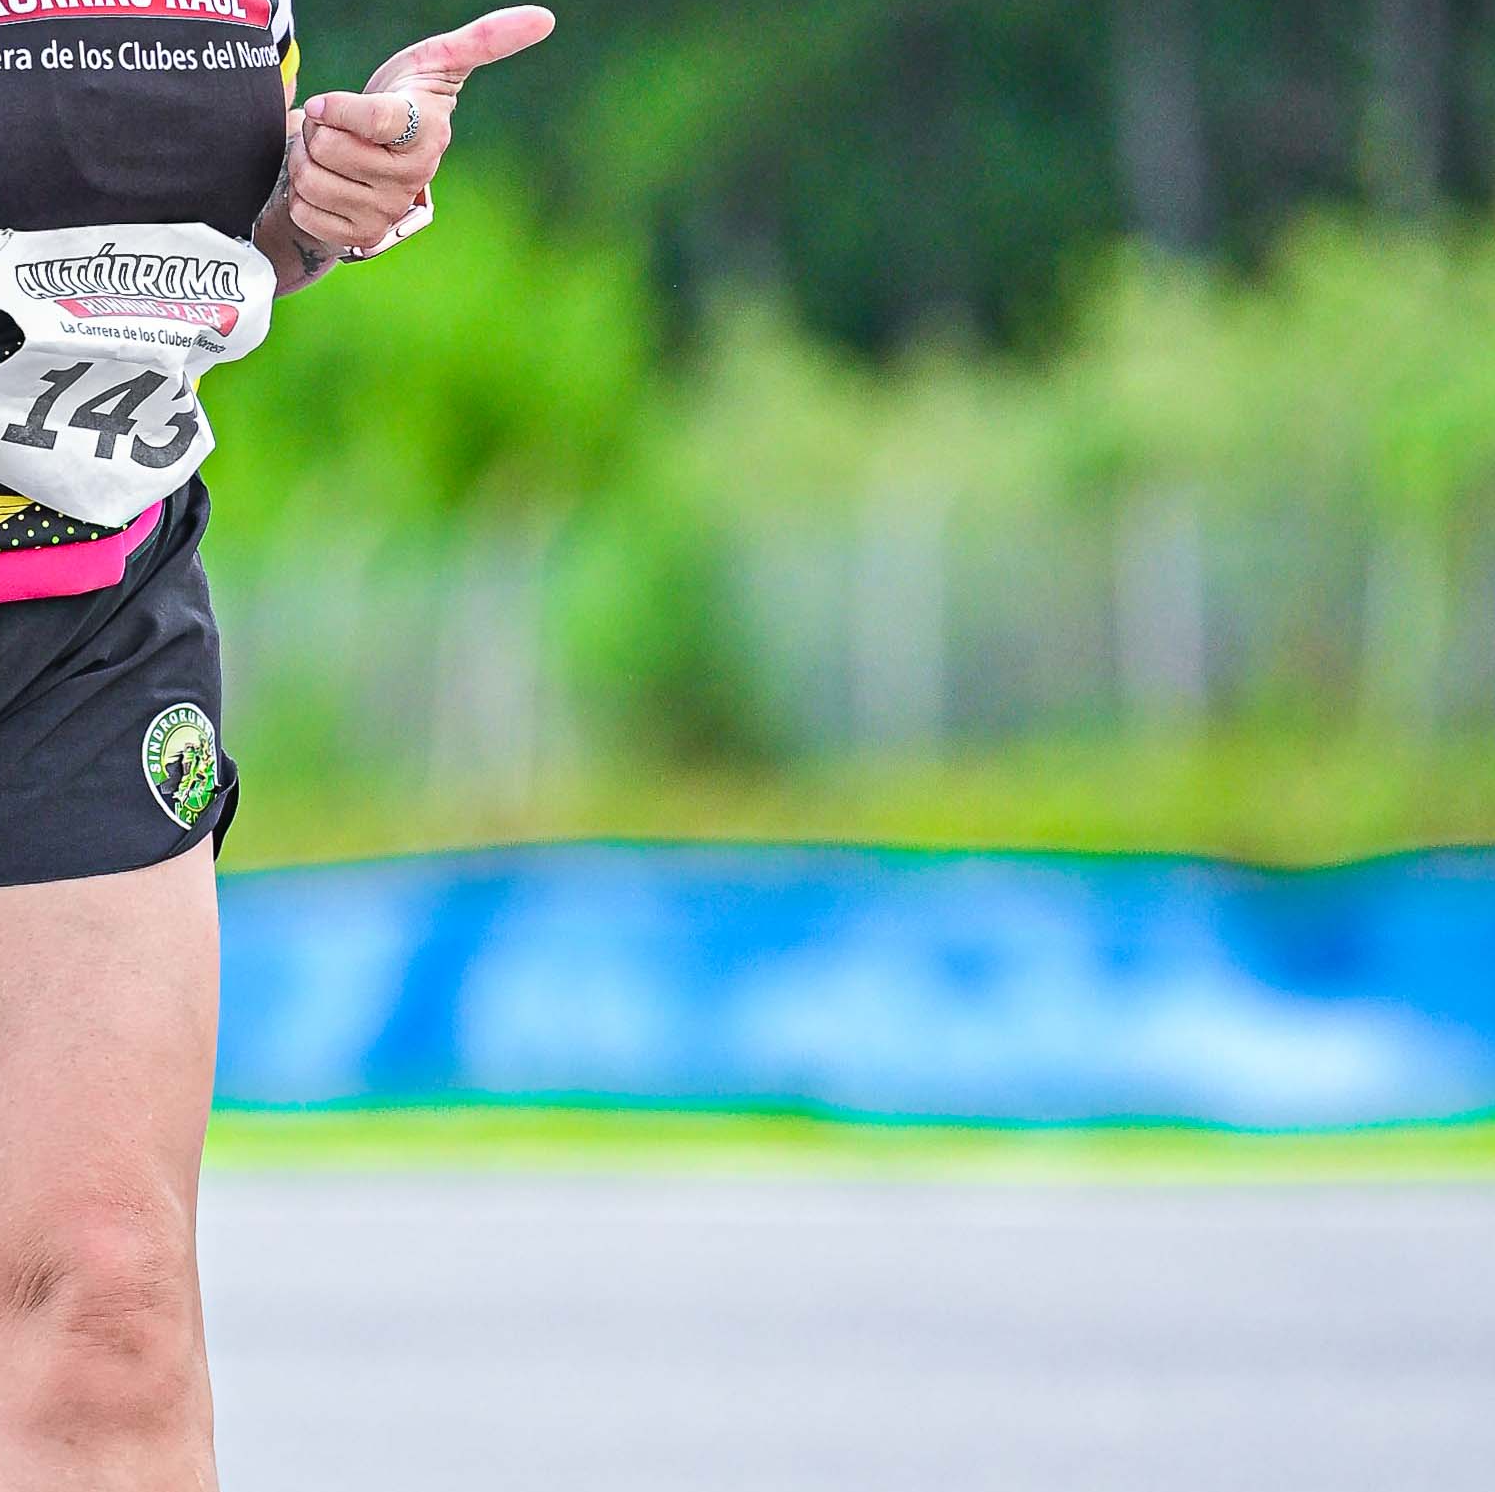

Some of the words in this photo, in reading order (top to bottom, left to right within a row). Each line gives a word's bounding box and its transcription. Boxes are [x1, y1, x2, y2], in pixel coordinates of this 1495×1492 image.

[41, 39, 72, 70] de
[78, 40, 114, 70] los
[118, 40, 199, 72] Clubes
[202, 40, 237, 70] del
[15, 243, 245, 302] AUTÓDROMO
[79, 298, 167, 317] RUNNING
[60, 320, 76, 334] La
[77, 322, 121, 340] Carrera
[123, 326, 138, 341] de
[139, 328, 156, 343] los
[158, 331, 193, 348] Clubes
[0, 361, 199, 469] 143
